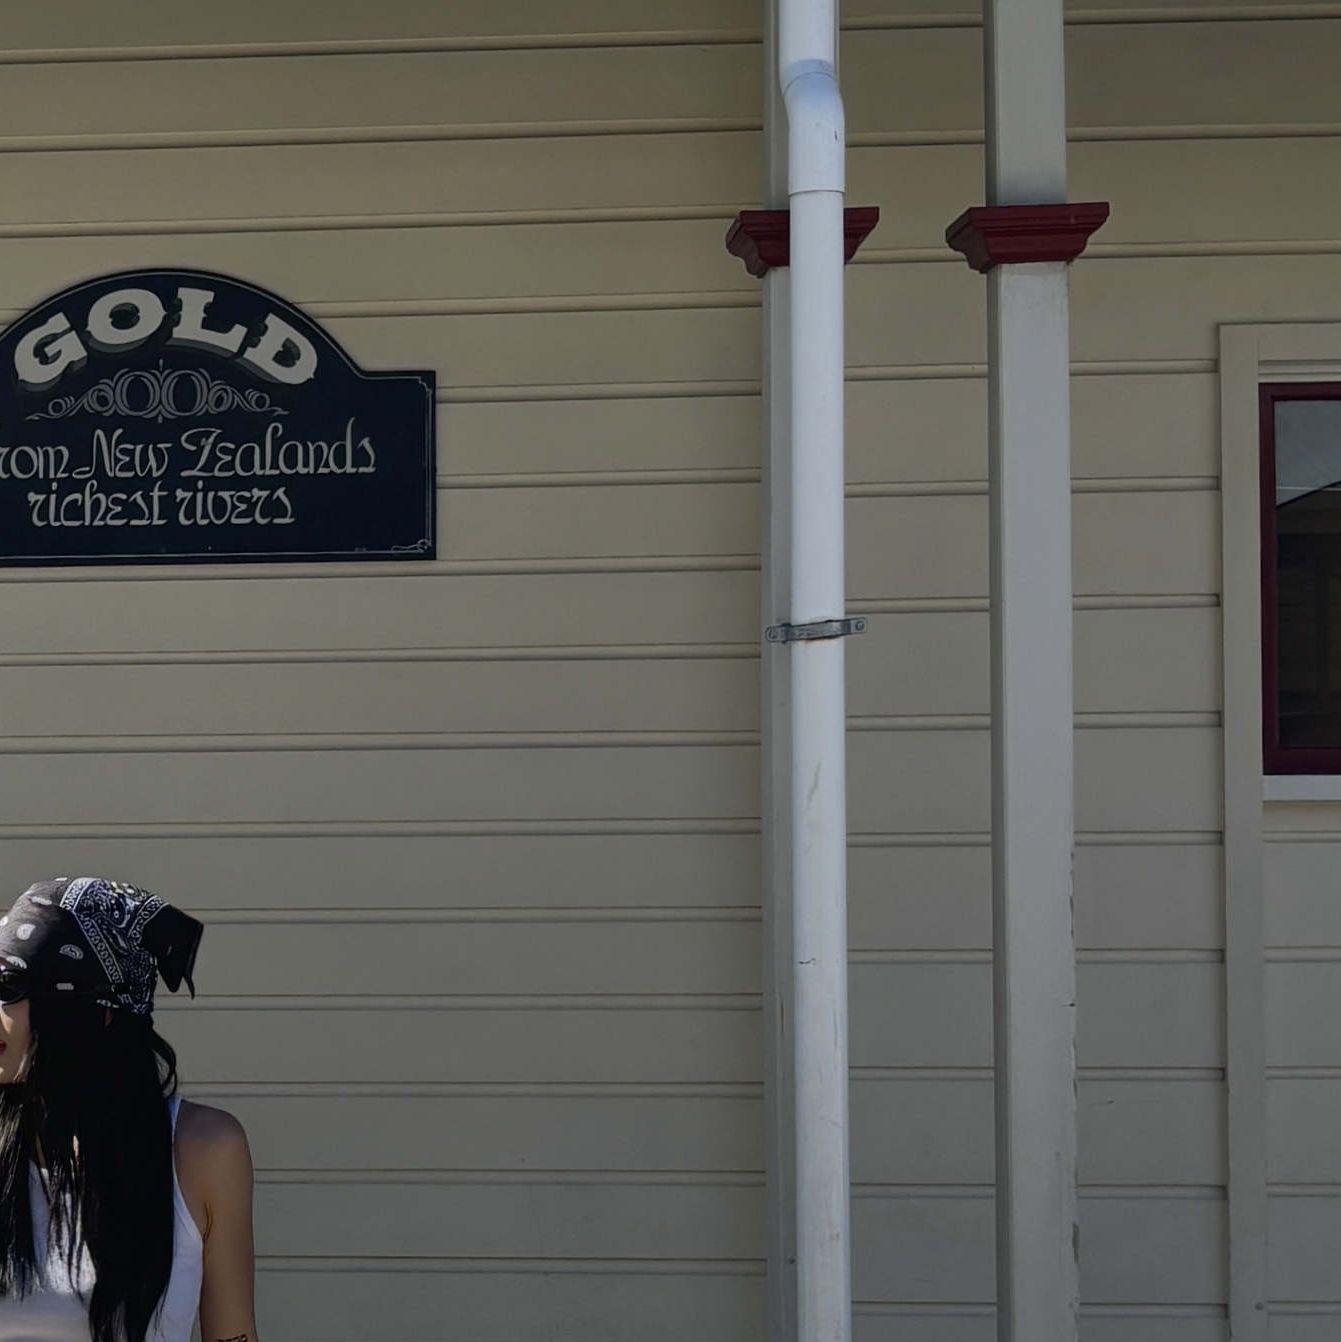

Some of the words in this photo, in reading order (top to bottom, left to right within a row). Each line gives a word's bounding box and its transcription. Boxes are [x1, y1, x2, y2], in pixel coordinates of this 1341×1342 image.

[12, 286, 319, 390] GOLD
[71, 427, 170, 480] New
[180, 417, 377, 479] Zealands
[29, 480, 167, 527] richest
[176, 485, 295, 526] rivers
